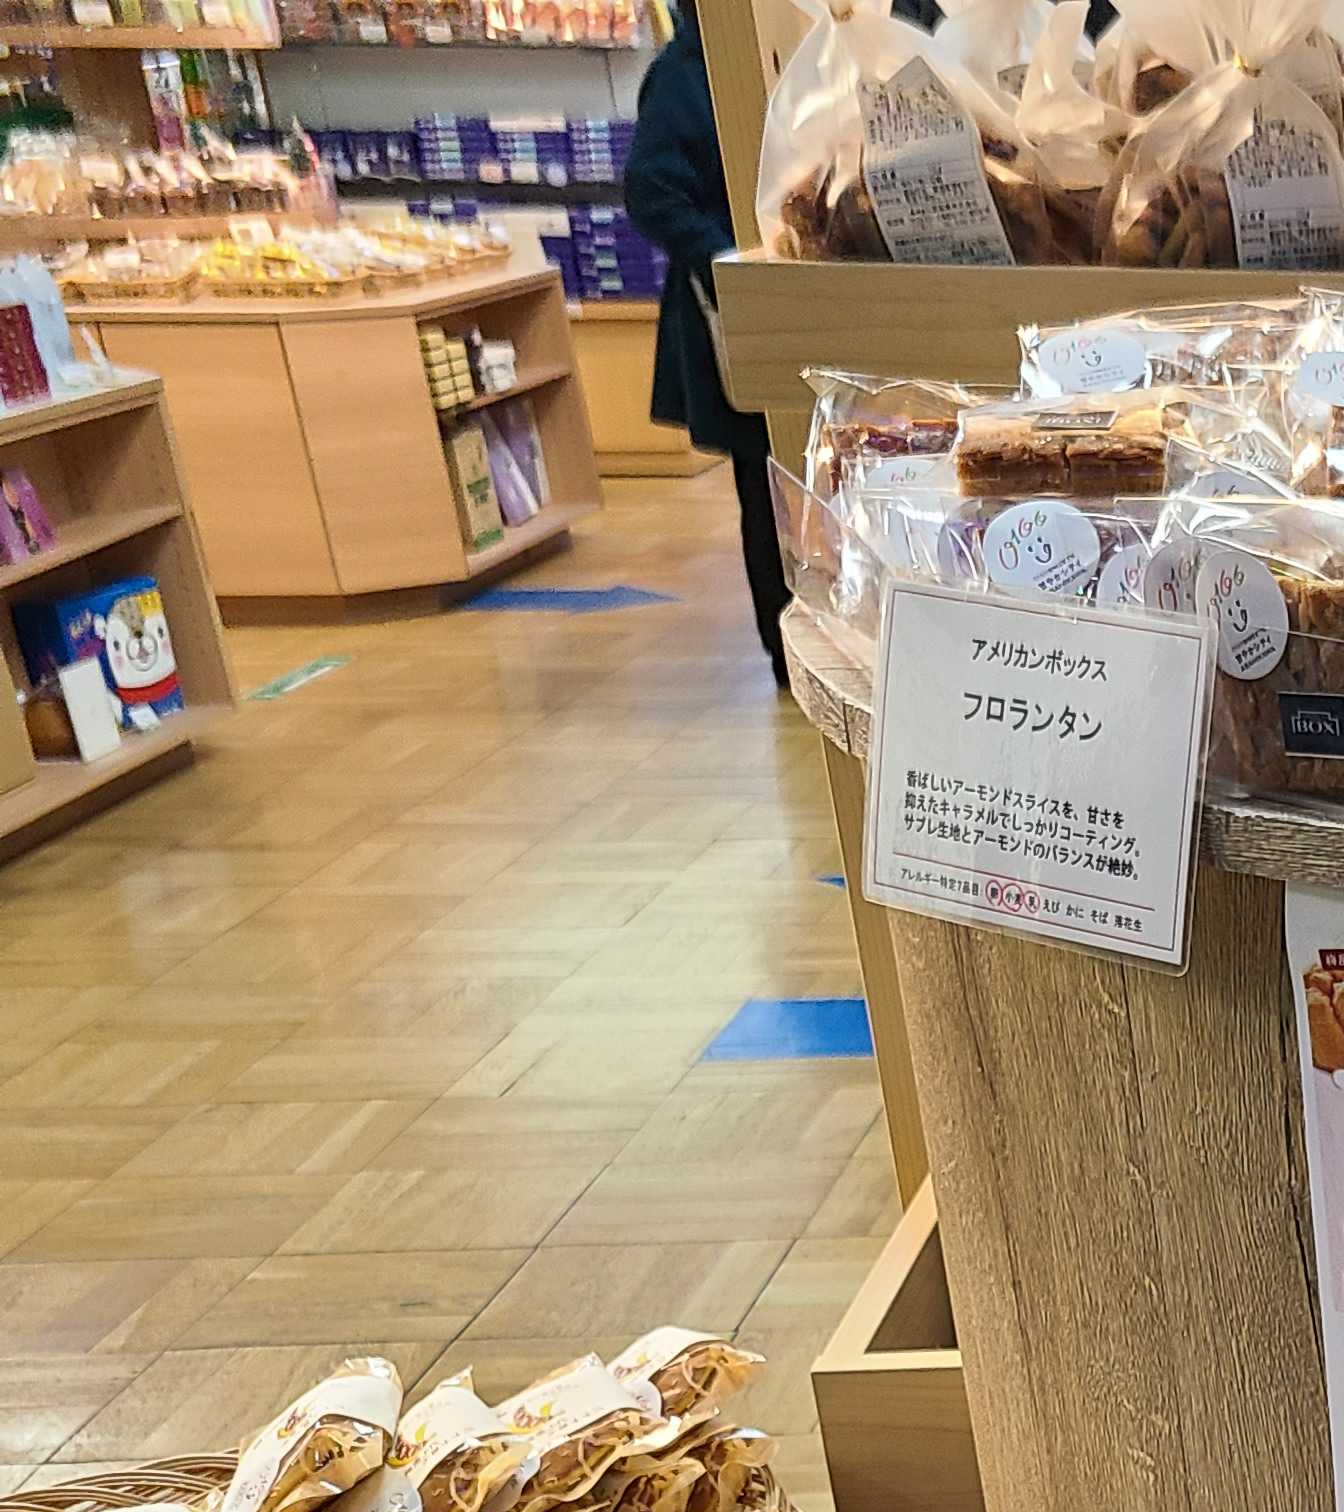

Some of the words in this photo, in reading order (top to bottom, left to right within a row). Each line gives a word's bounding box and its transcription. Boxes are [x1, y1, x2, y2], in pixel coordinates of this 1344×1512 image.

[971, 638, 1108, 681] アメリカンボックス
[962, 692, 1103, 741] フロランタン
[1296, 717, 1334, 735] BOX
